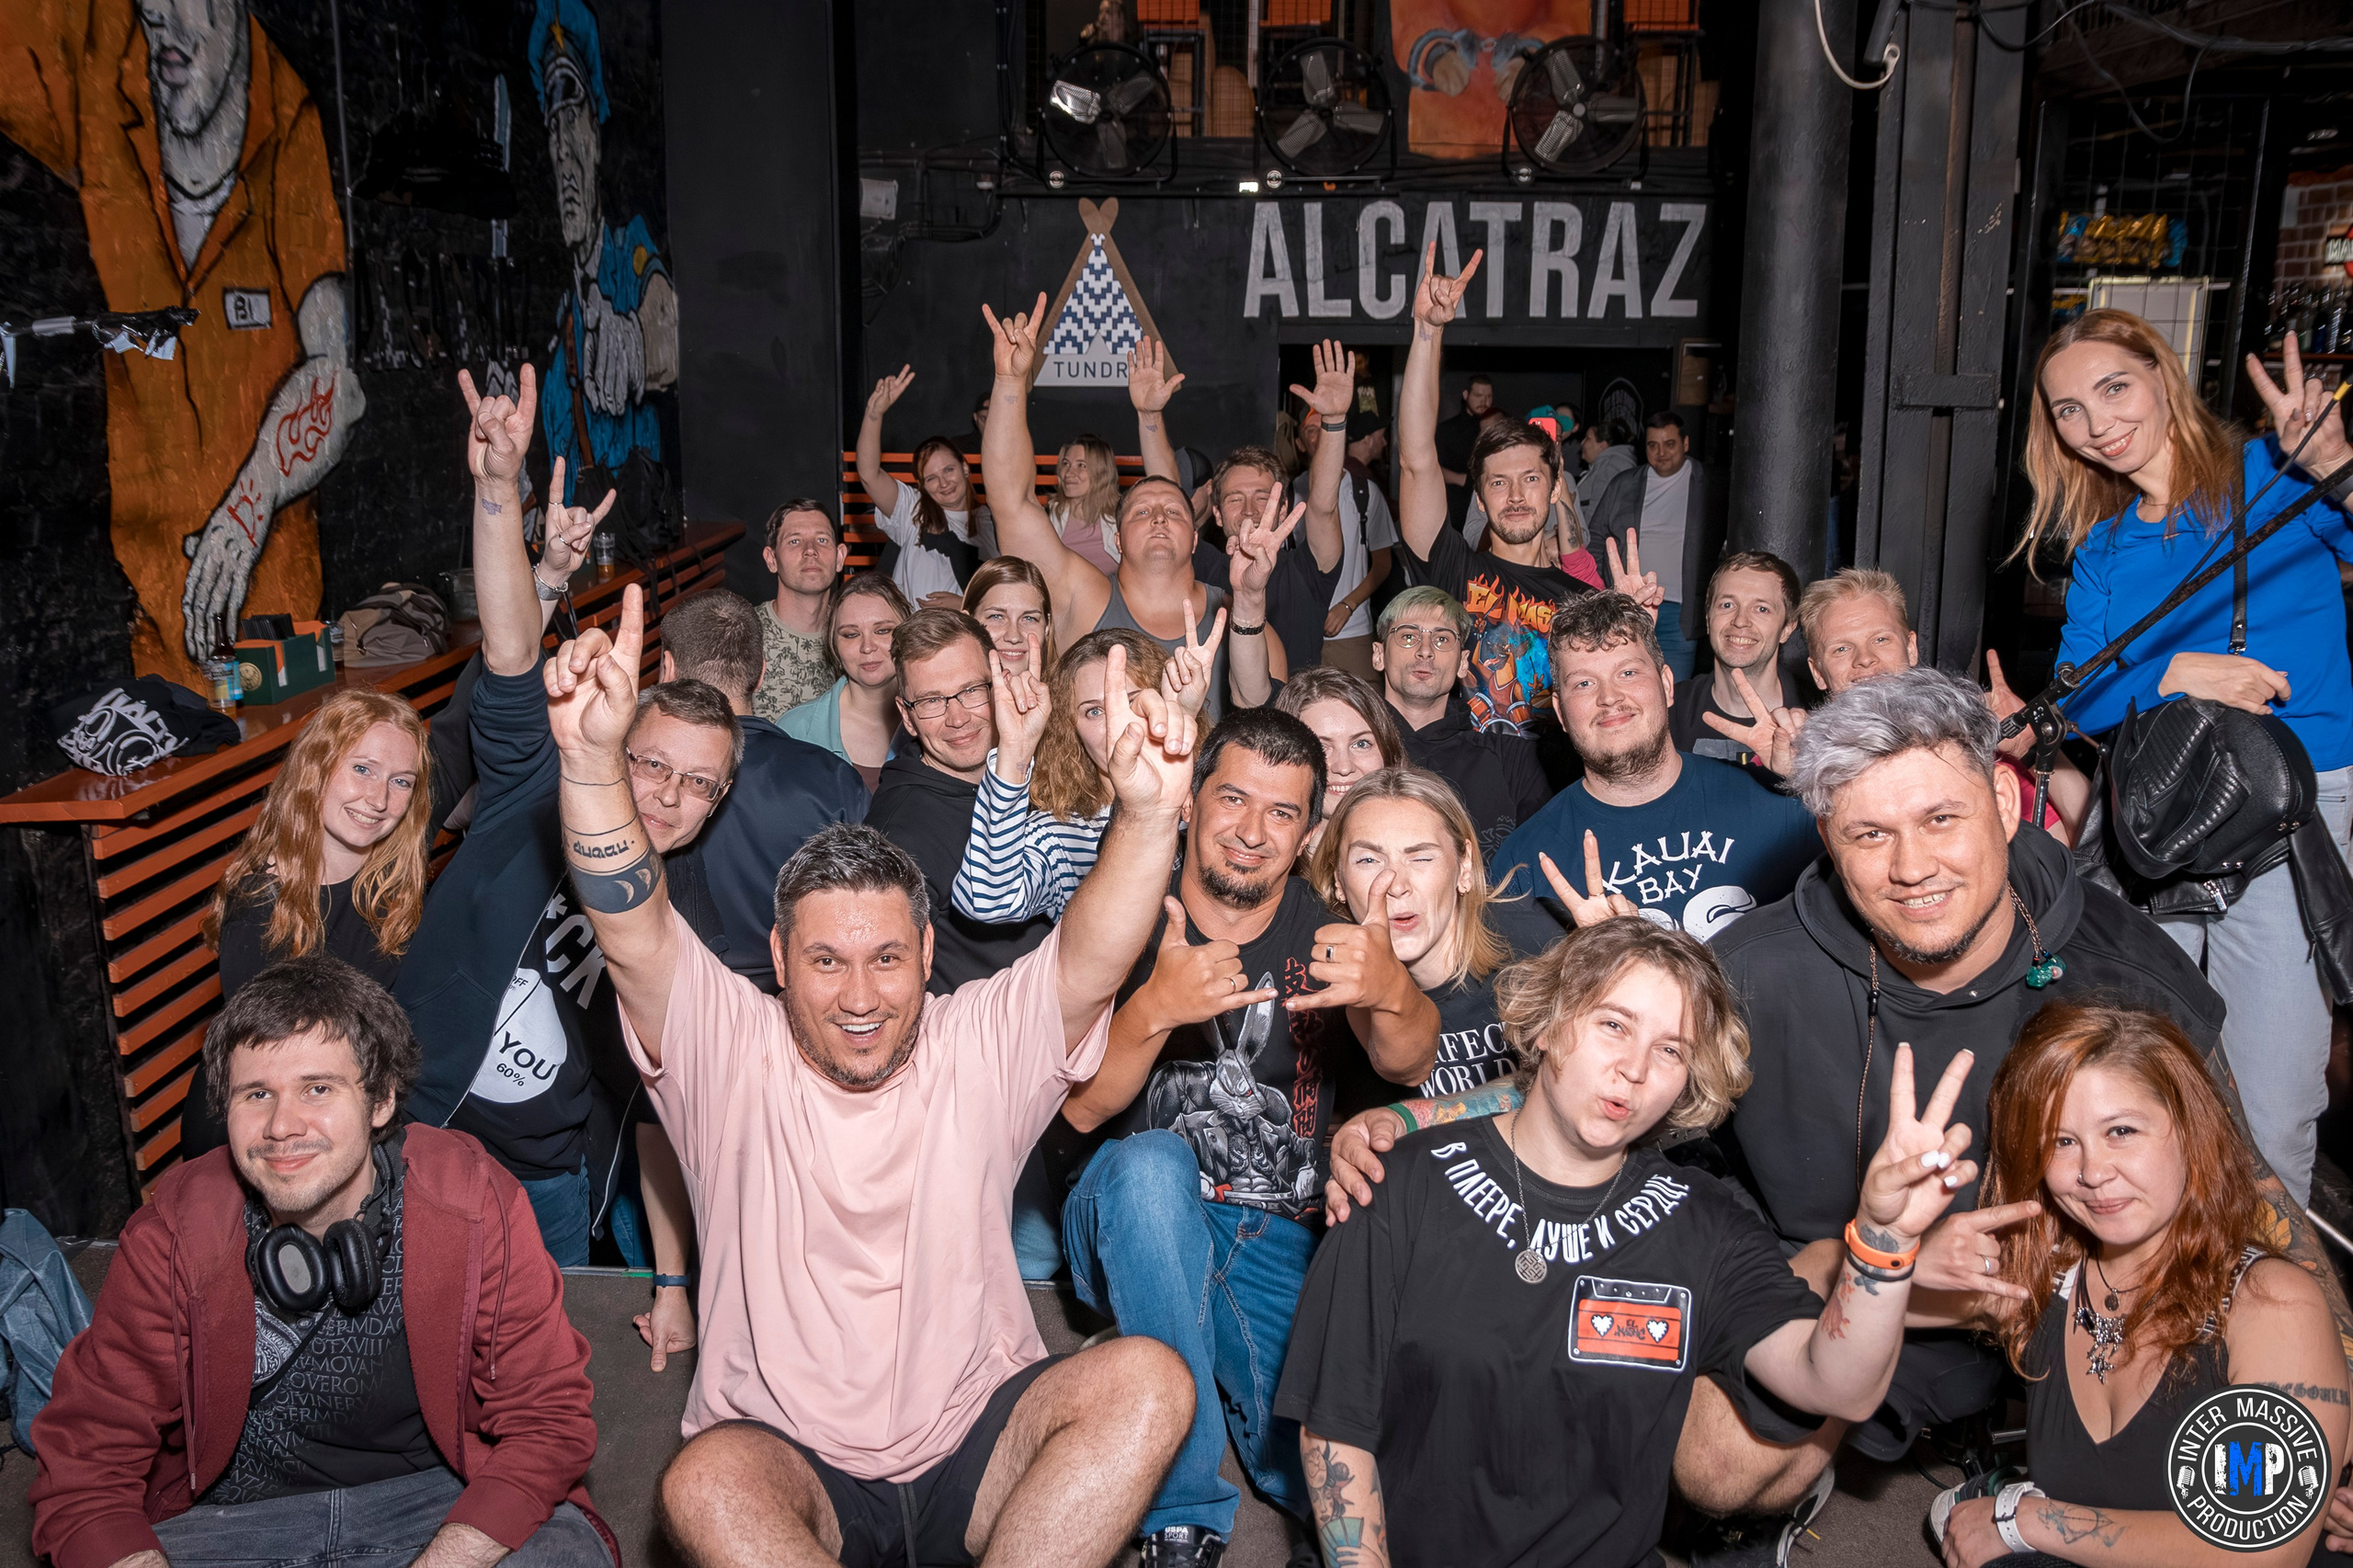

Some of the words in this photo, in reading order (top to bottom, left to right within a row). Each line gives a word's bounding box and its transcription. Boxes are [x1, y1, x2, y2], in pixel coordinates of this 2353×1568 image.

[1244, 200, 1707, 319] ALCATRAZ
[1053, 361, 1128, 378] TUNDR
[1466, 579, 1503, 619] EL
[1507, 592, 1554, 634] MAS
[1602, 830, 1735, 894] KAUAI
[1636, 864, 1702, 904] BAY
[545, 893, 607, 1009] CK
[499, 1030, 557, 1081] YOU
[1435, 1021, 1507, 1063] FEC
[496, 1062, 525, 1087] 60%
[1431, 1142, 1467, 1159] В
[1444, 1158, 1523, 1249] ПЛЕЕРЕ,
[1614, 1174, 1691, 1236] СЕРДЦЕ
[1594, 1214, 1617, 1249] И
